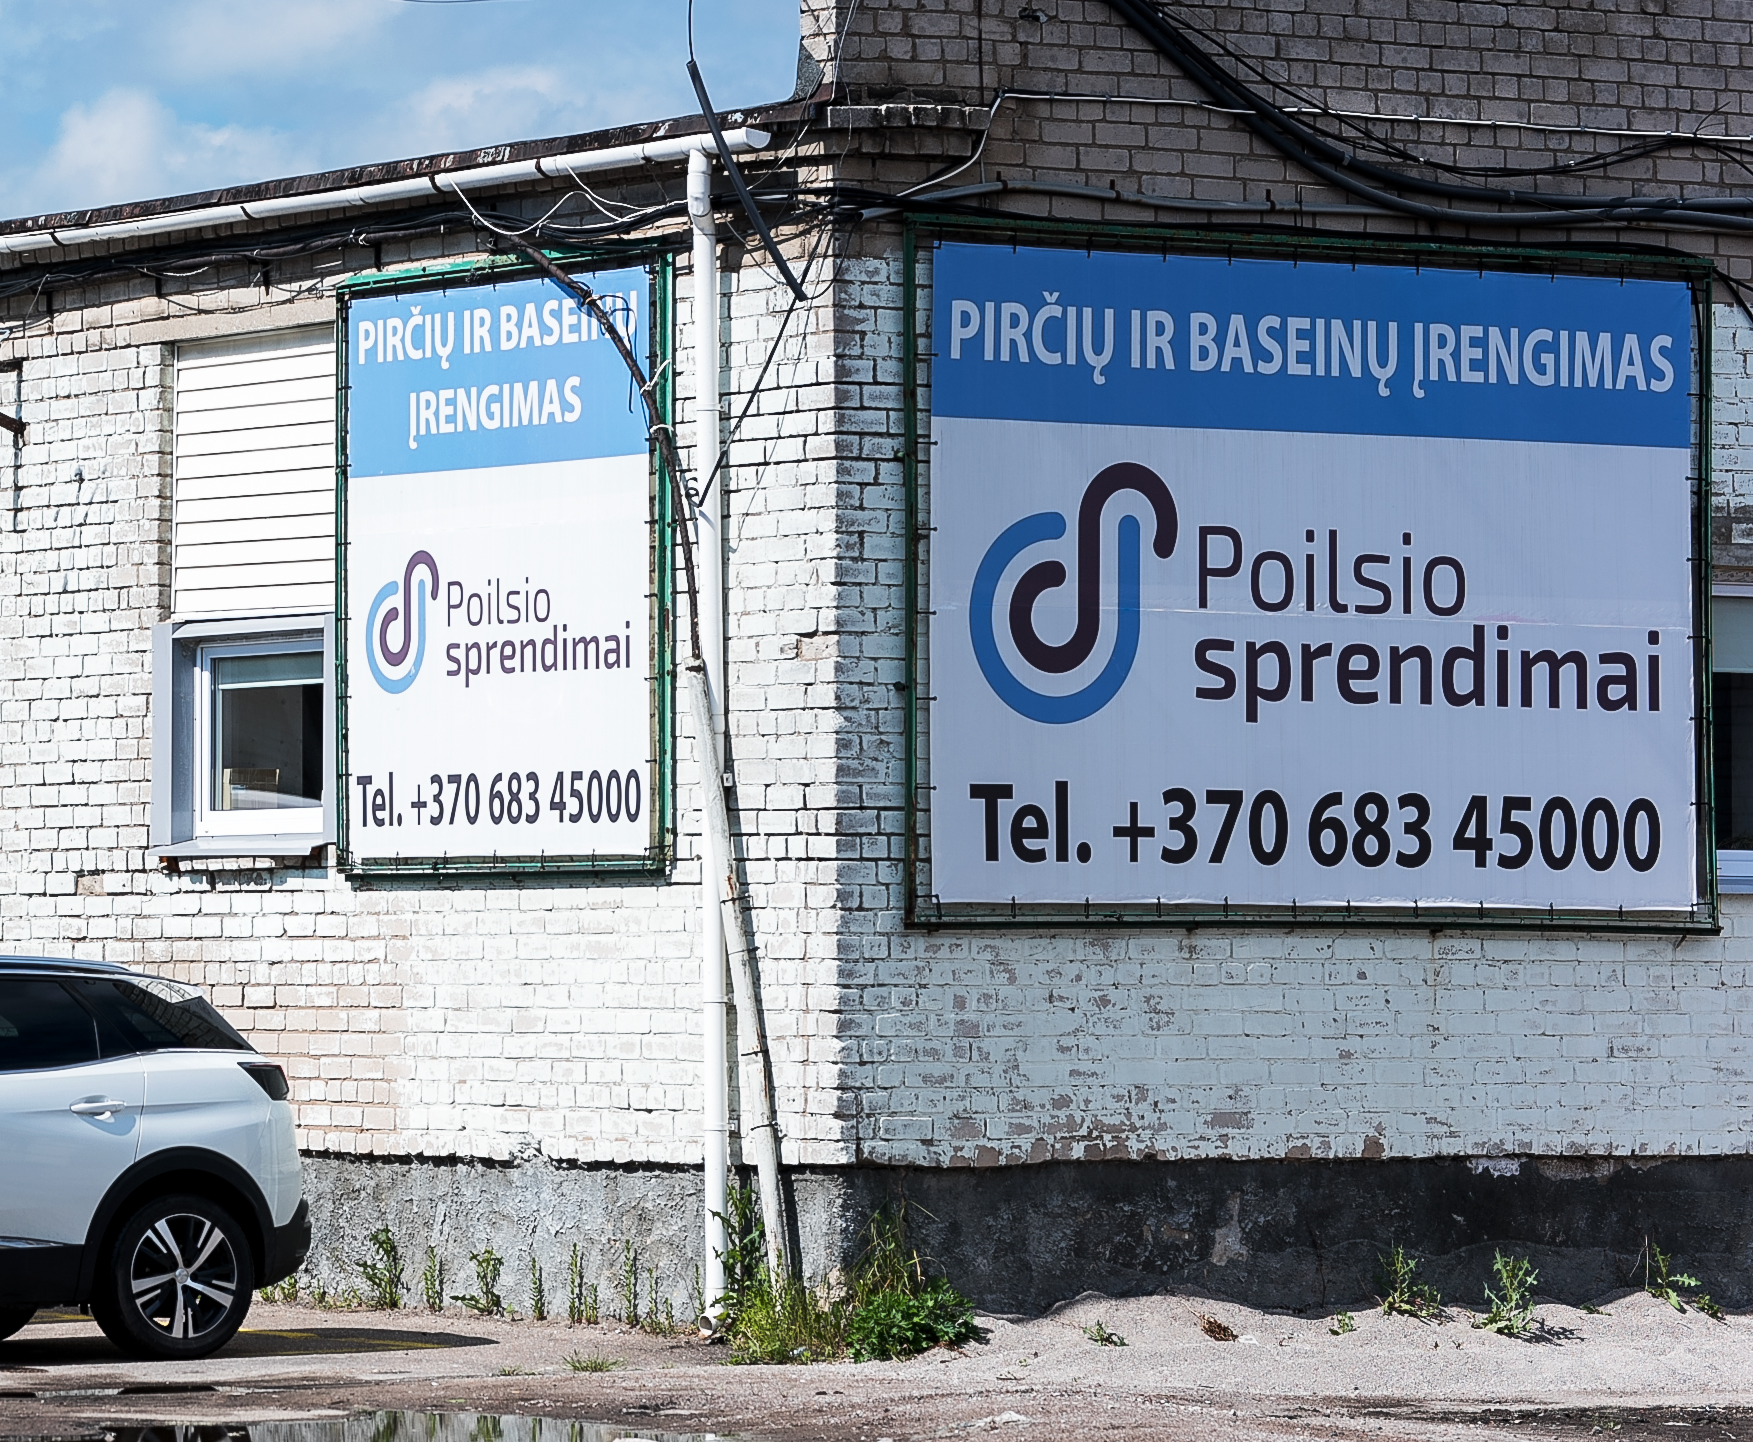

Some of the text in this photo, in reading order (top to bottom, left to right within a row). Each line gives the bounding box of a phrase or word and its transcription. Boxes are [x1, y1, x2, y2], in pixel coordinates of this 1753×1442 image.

[358, 303, 455, 371] PIRČIŲ
[463, 308, 493, 355] IR
[950, 290, 1675, 399] PIRČIŲ IR BASEINŲ ĮRENGIMAS
[407, 375, 583, 450] ĮRENGIMAS
[447, 576, 551, 628] Poilsio
[1198, 524, 1466, 617] Poilsio
[446, 620, 632, 688] sprendimai
[1194, 623, 1660, 724] sprendimai
[356, 768, 643, 829] Tel. +370 683 45000
[969, 780, 1661, 873] Tel. +370 683 45000
